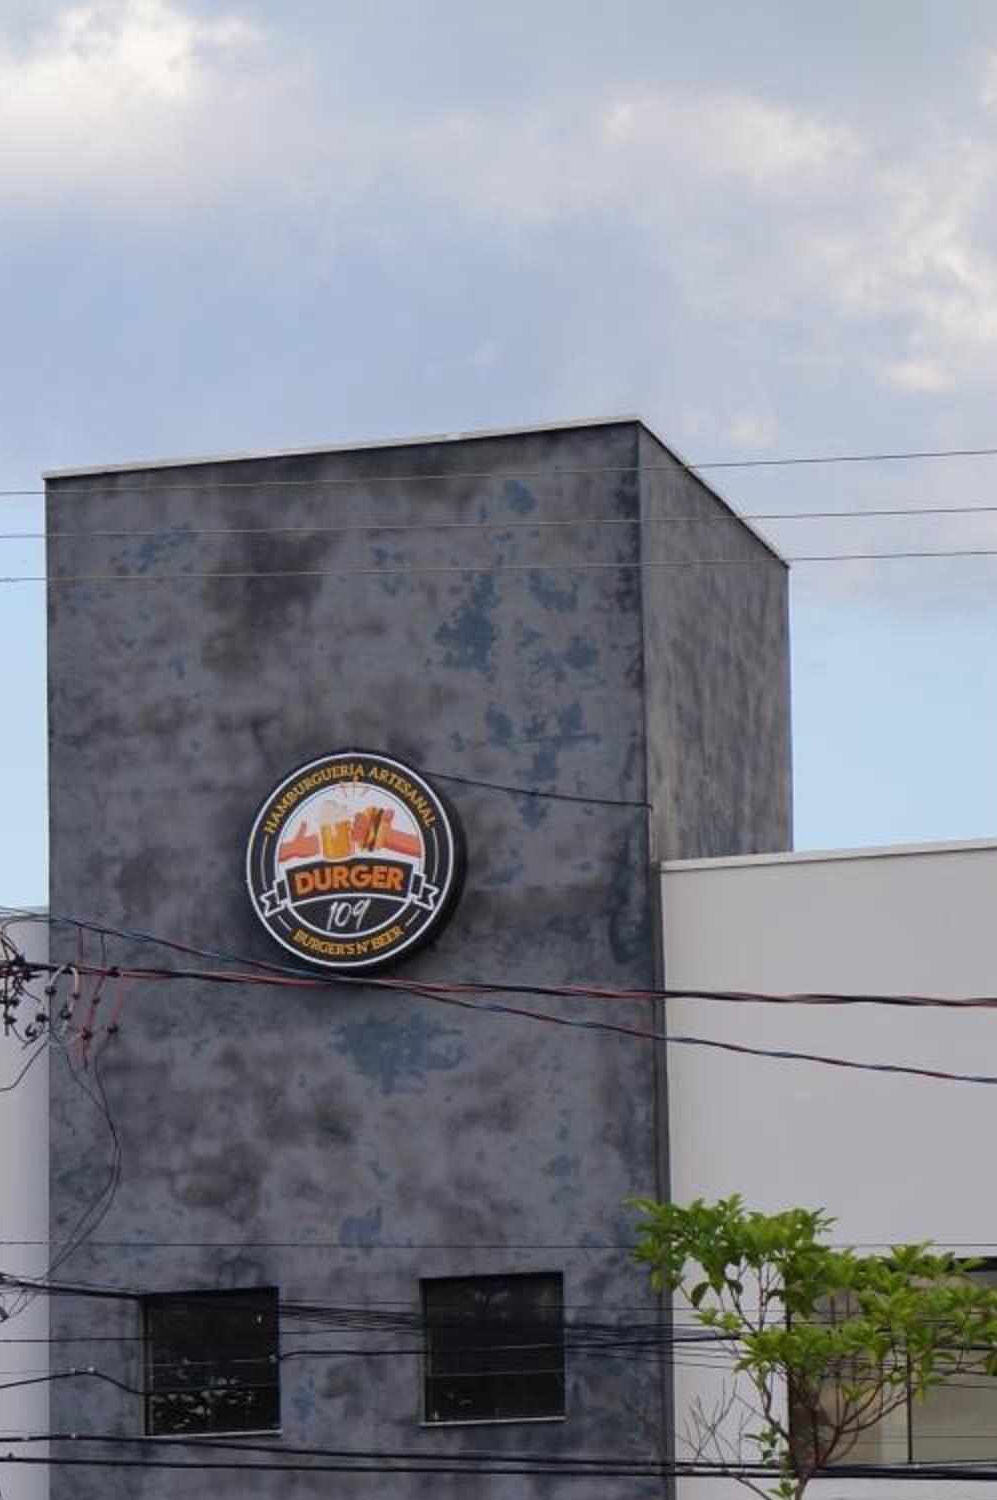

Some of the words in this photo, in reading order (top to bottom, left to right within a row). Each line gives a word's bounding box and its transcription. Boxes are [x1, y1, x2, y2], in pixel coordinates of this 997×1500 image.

[264, 763, 364, 834] HAMBURGUERIA
[369, 766, 437, 829] ARTESANAL
[295, 865, 404, 897] DURGER
[327, 899, 371, 931] 109
[370, 926, 404, 949] BEER
